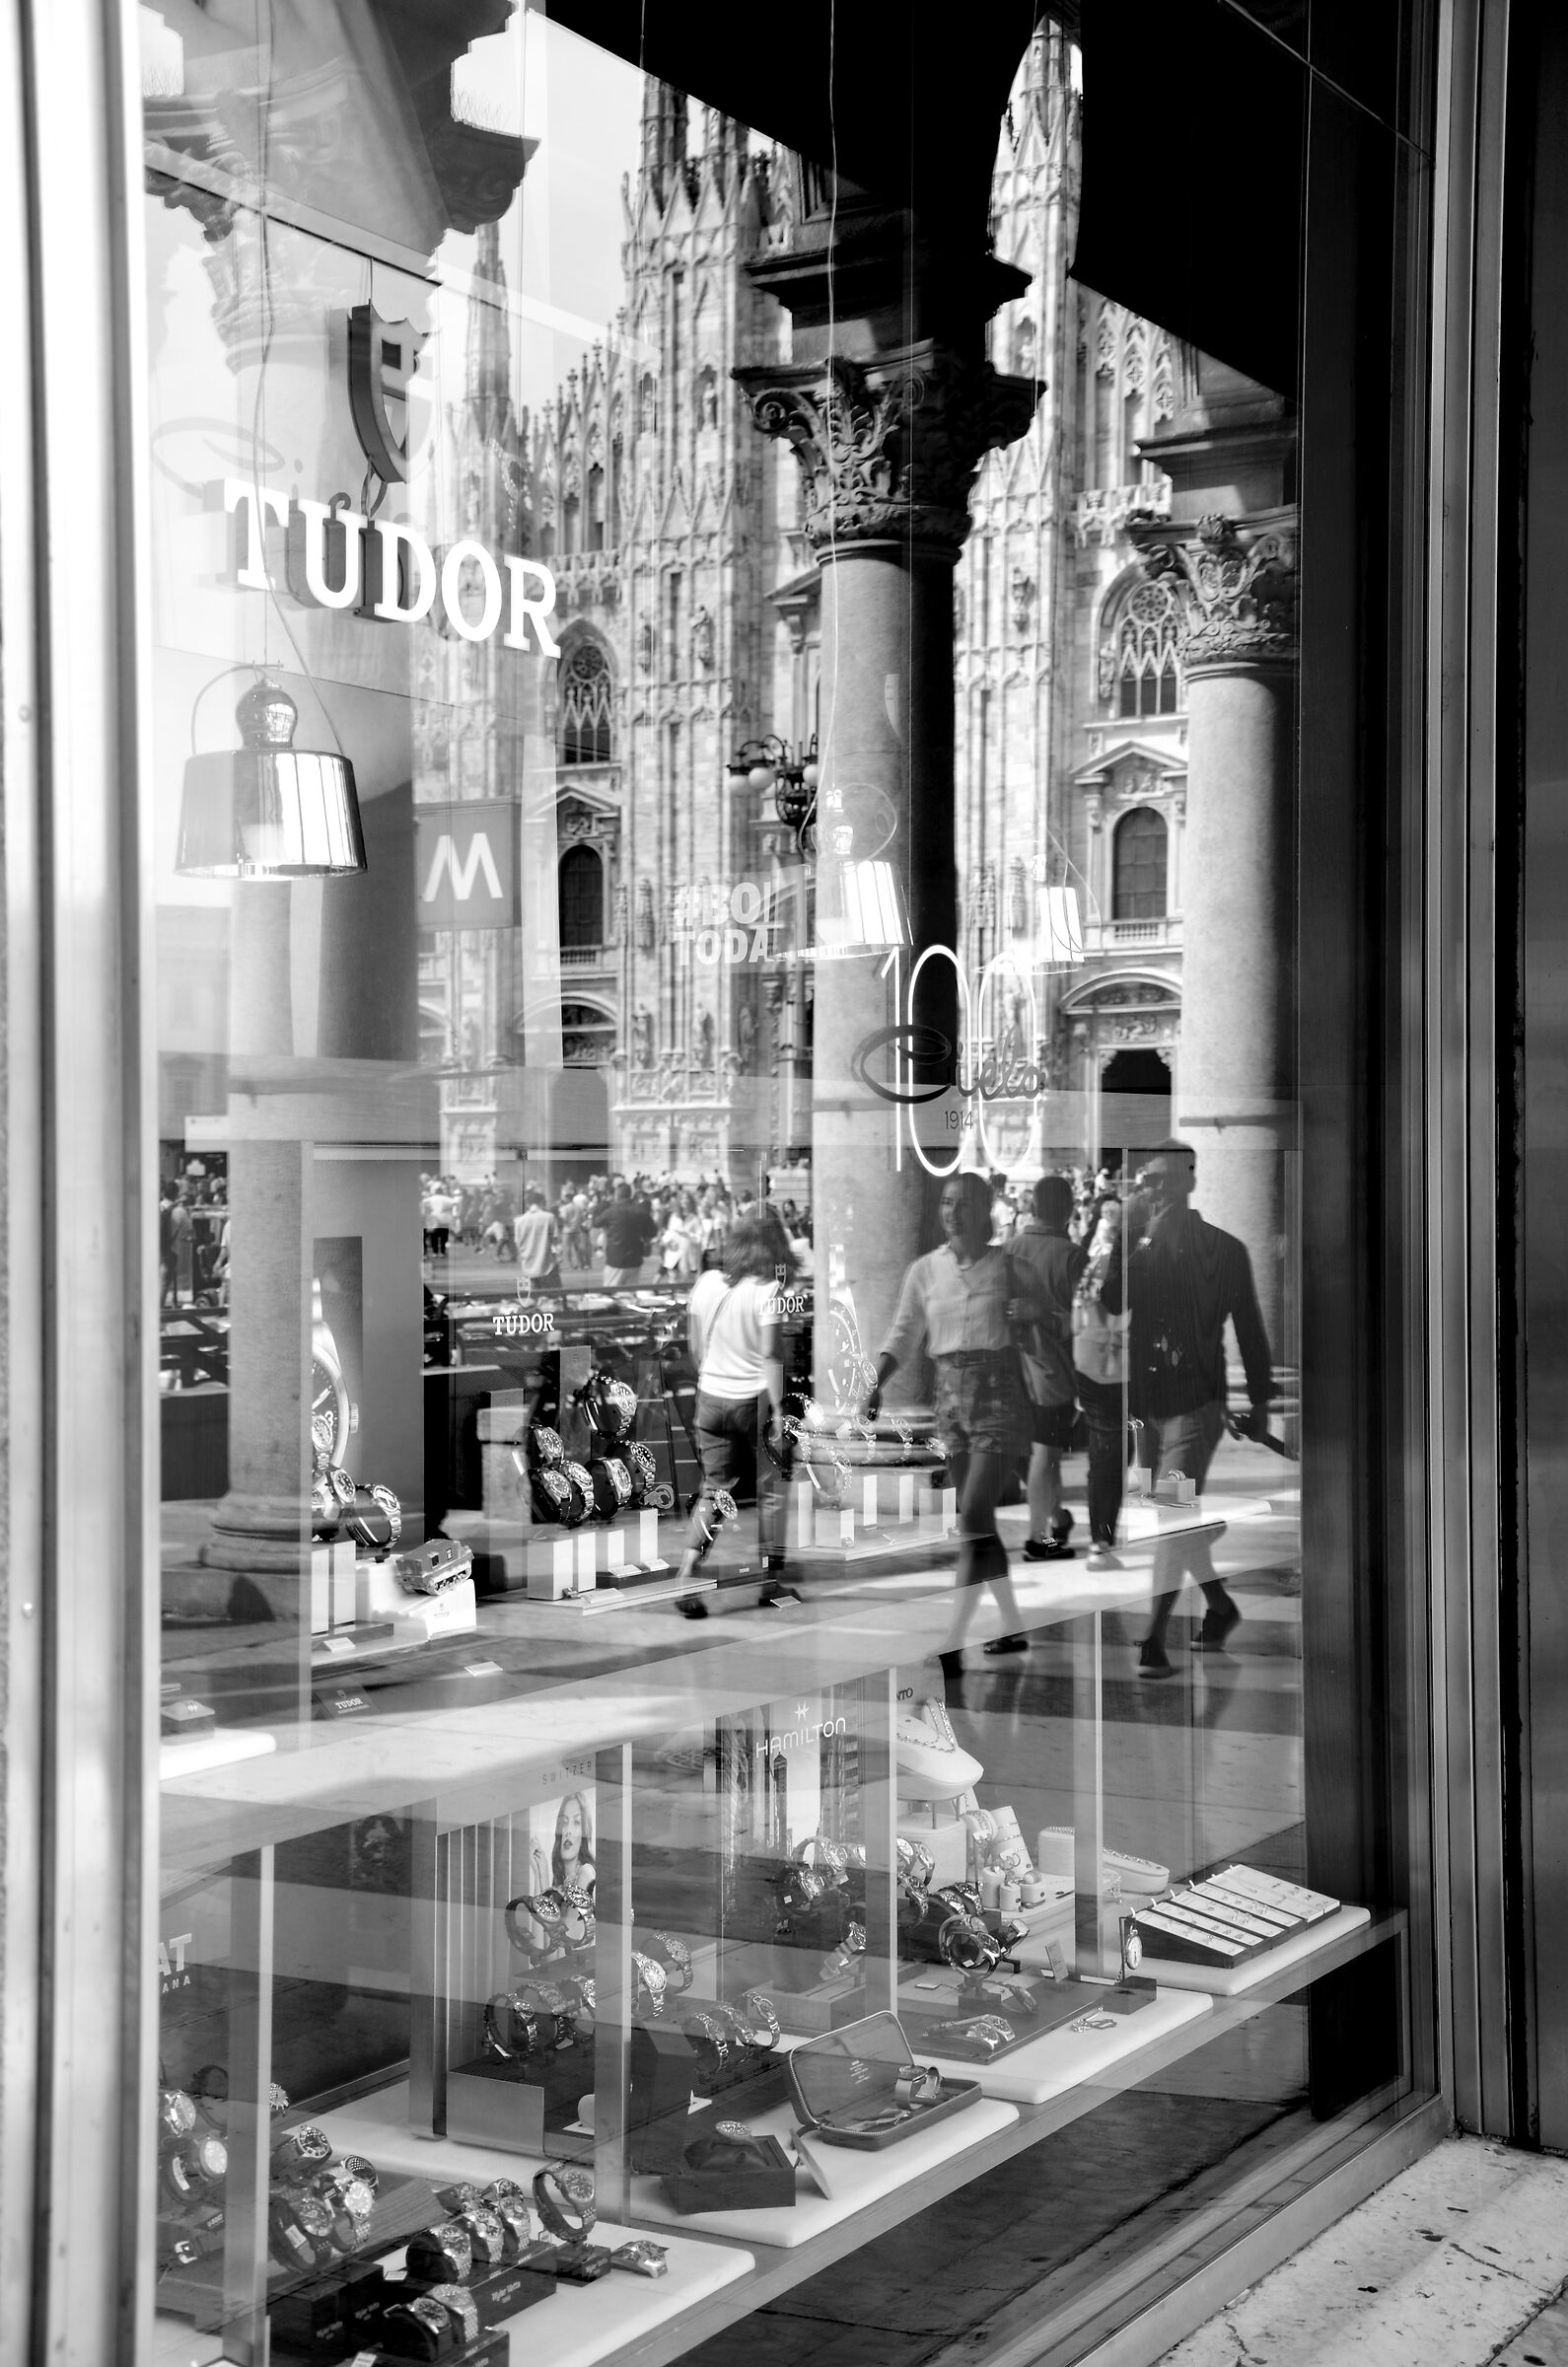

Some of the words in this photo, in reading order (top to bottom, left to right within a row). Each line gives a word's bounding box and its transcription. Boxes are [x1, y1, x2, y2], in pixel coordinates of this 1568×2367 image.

[223, 477, 562, 659] TUDOR
[422, 832, 504, 902] M
[881, 944, 1036, 1177] 100
[945, 1111, 974, 1130] 1914
[757, 1296, 805, 1316] TUDOR
[493, 1313, 554, 1335] TUDOR
[335, 1697, 363, 1709] TUDOR
[756, 1717, 846, 1758] HAMILTON
